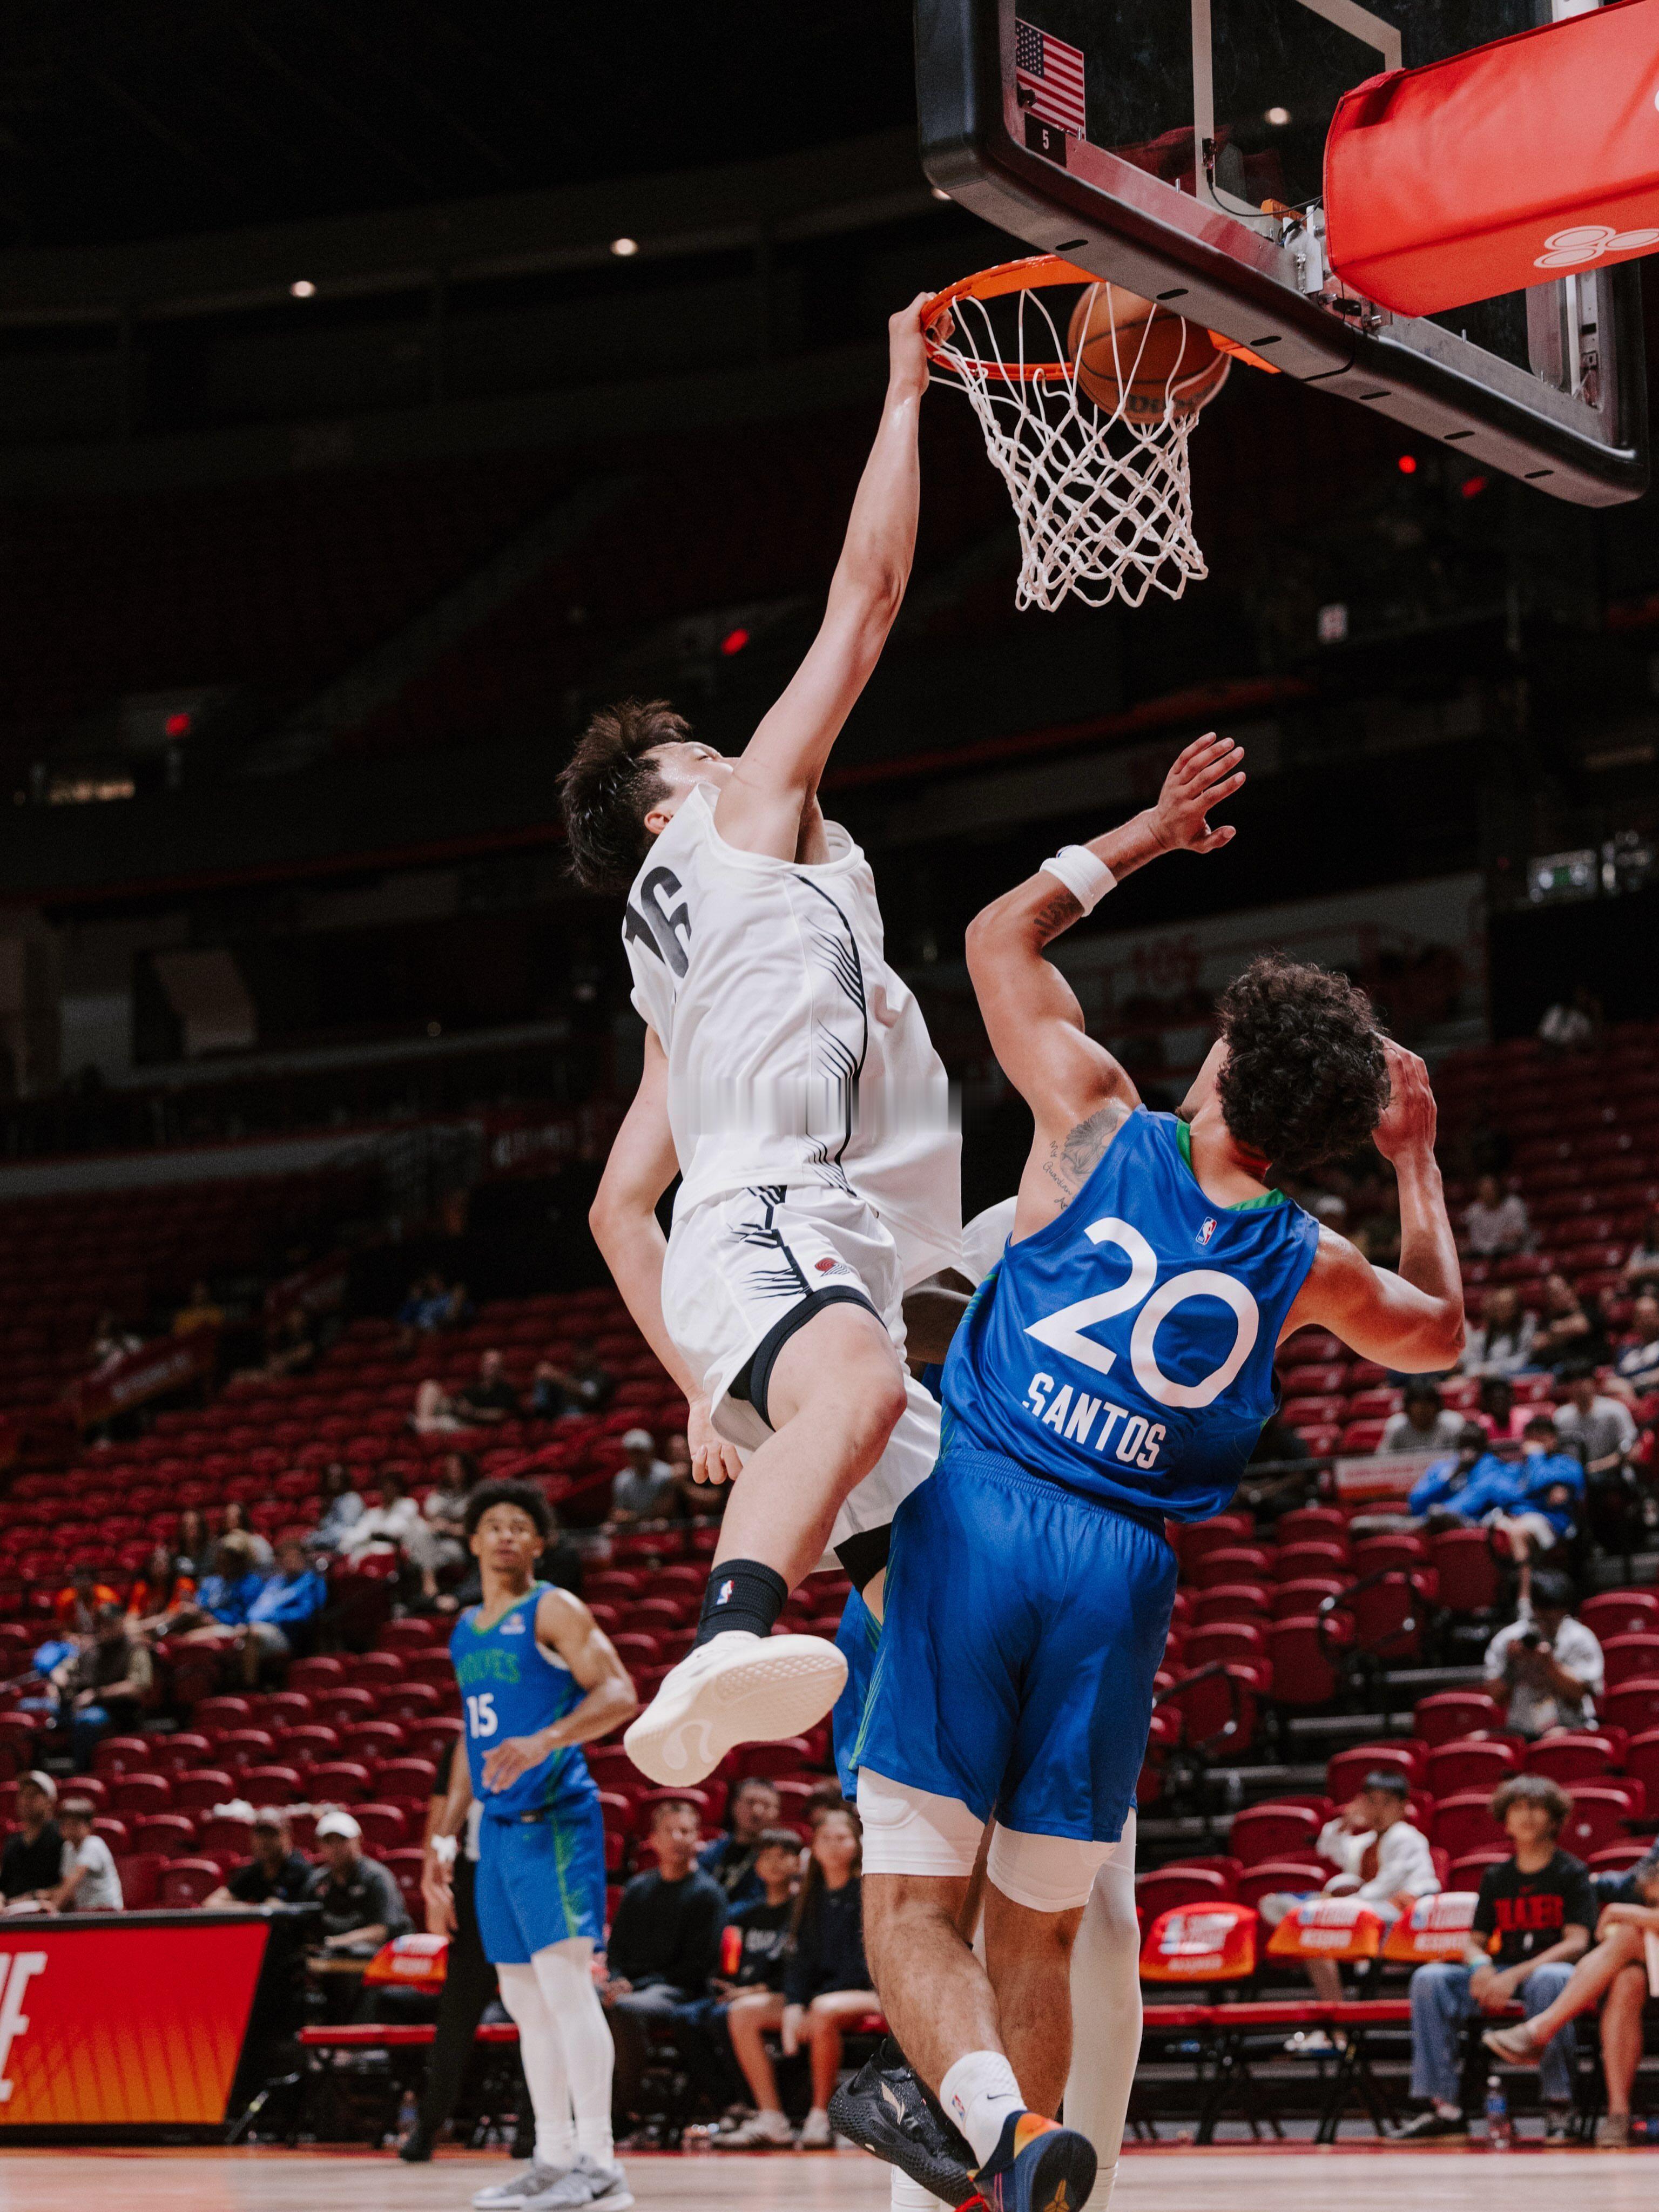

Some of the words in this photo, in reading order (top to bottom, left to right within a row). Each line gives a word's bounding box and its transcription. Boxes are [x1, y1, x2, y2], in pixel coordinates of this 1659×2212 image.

[1042, 129, 1049, 150] 5
[625, 866, 692, 979] 16
[1043, 1161, 1072, 1196] Guardian
[1023, 1217, 1259, 1408] 20
[1022, 1372, 1166, 1469] SANTOS
[467, 1692, 498, 1738] 15
